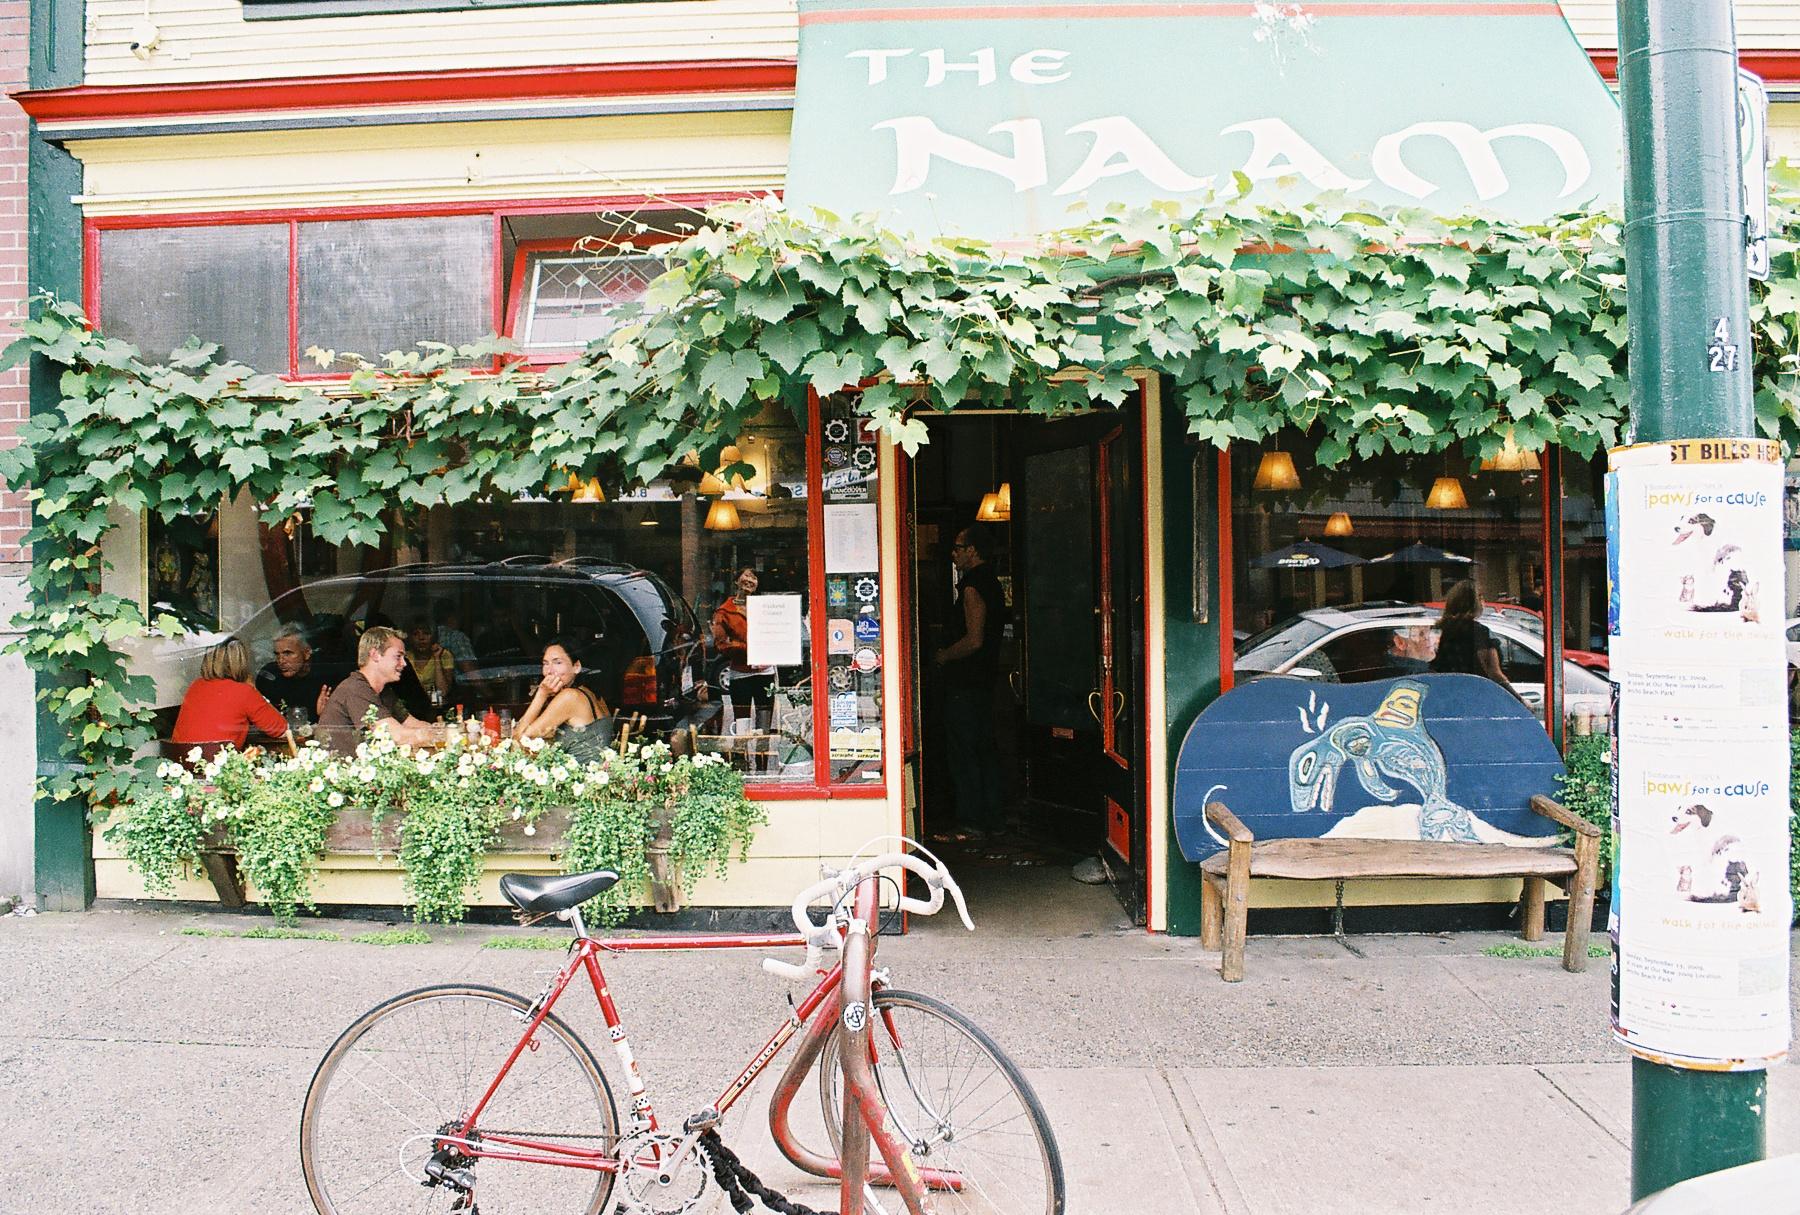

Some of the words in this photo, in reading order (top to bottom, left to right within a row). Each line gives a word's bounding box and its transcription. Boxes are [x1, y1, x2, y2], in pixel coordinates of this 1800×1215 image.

[846, 47, 1072, 88] THE
[870, 115, 1593, 201] NAAM
[1714, 318, 1729, 343] 4
[1708, 346, 1737, 373] 27
[1700, 443, 1750, 461] BILLS
[1649, 491, 1693, 508] paws
[1694, 494, 1712, 505] for
[1715, 495, 1723, 504] a
[1726, 491, 1767, 507] cause
[1648, 781, 1691, 796] paws
[1692, 785, 1710, 796] for
[1713, 787, 1721, 795] a
[1724, 780, 1769, 798] cause
